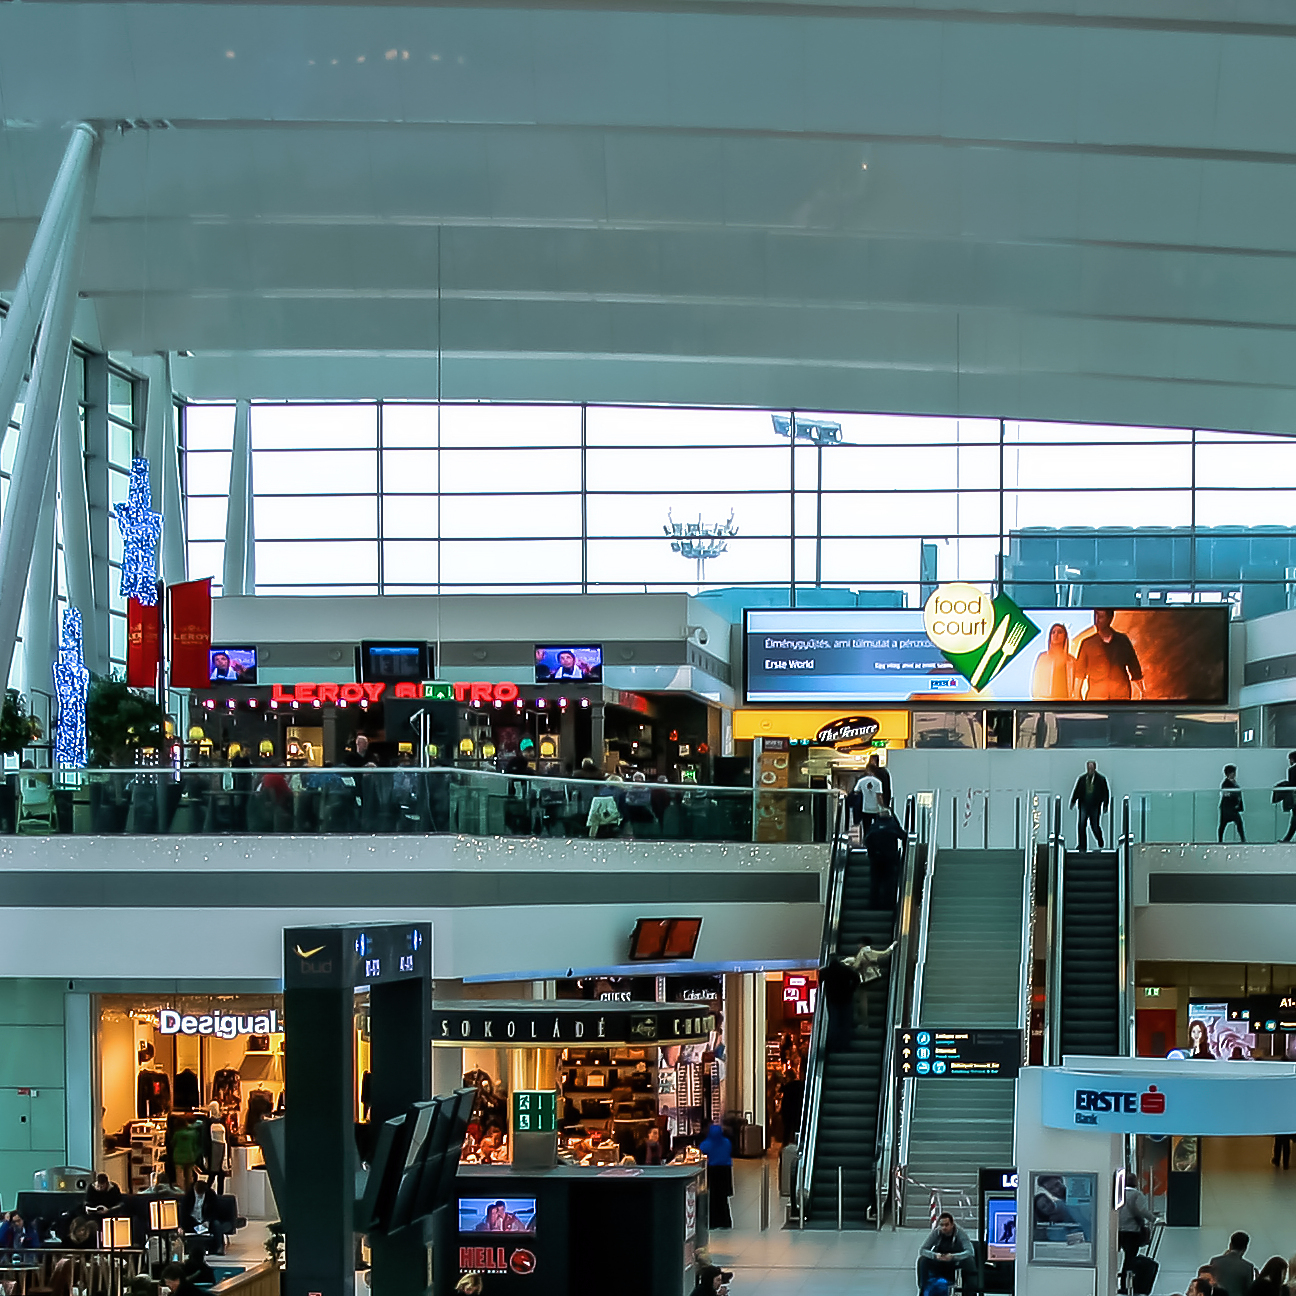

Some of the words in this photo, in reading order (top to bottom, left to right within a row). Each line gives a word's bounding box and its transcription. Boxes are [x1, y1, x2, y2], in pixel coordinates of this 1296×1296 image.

[934, 596, 982, 615] food
[932, 618, 988, 636] court
[271, 682, 386, 702] LEROY
[394, 681, 519, 702] BITRO
[441, 1017, 605, 1038] SOKOLÁDÉ
[1075, 1090, 1138, 1114] ERSTE
[1075, 1112, 1099, 1125] Bank
[459, 1247, 508, 1269] HELL
